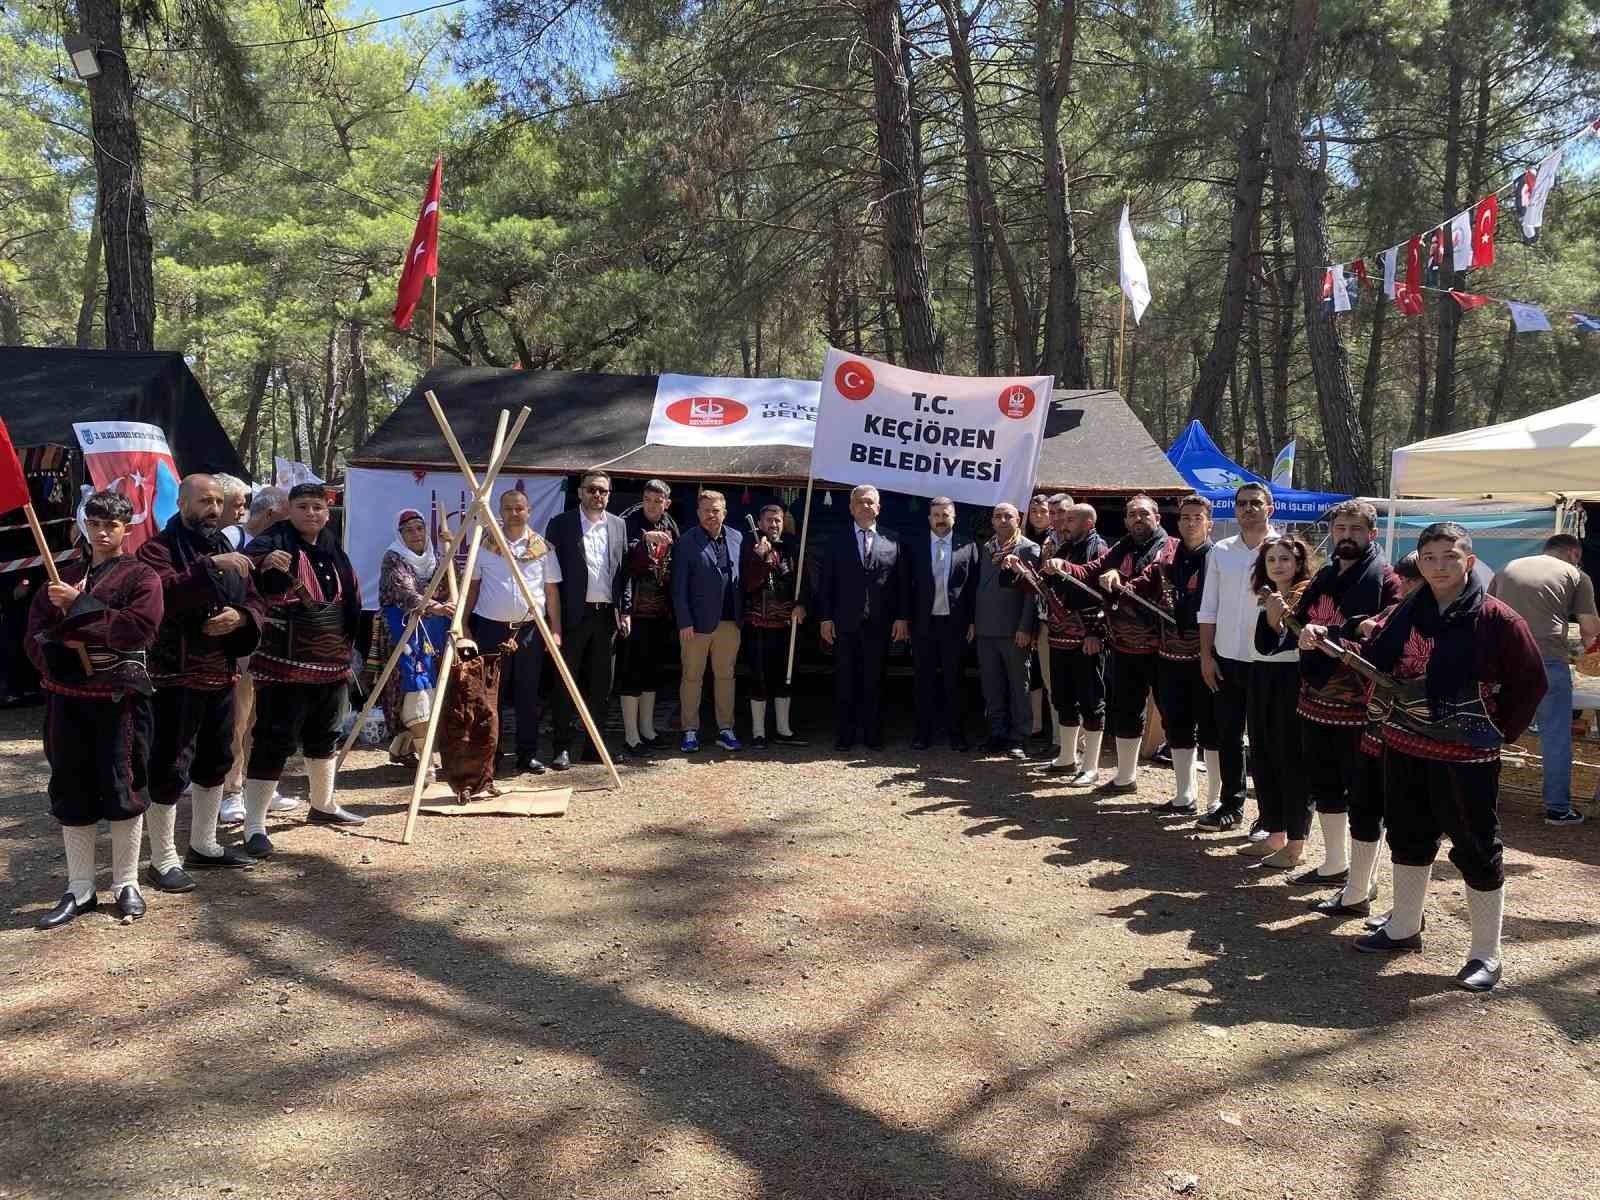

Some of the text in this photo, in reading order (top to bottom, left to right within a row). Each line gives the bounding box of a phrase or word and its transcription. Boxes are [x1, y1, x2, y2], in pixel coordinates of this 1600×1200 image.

[912, 392, 954, 415] T.C.
[864, 413, 996, 450] KEÇİÖREN
[849, 442, 1002, 483] BELEDİYESİ
[1273, 500, 1287, 510] ÜR
[1289, 501, 1316, 513] İŞLERİ
